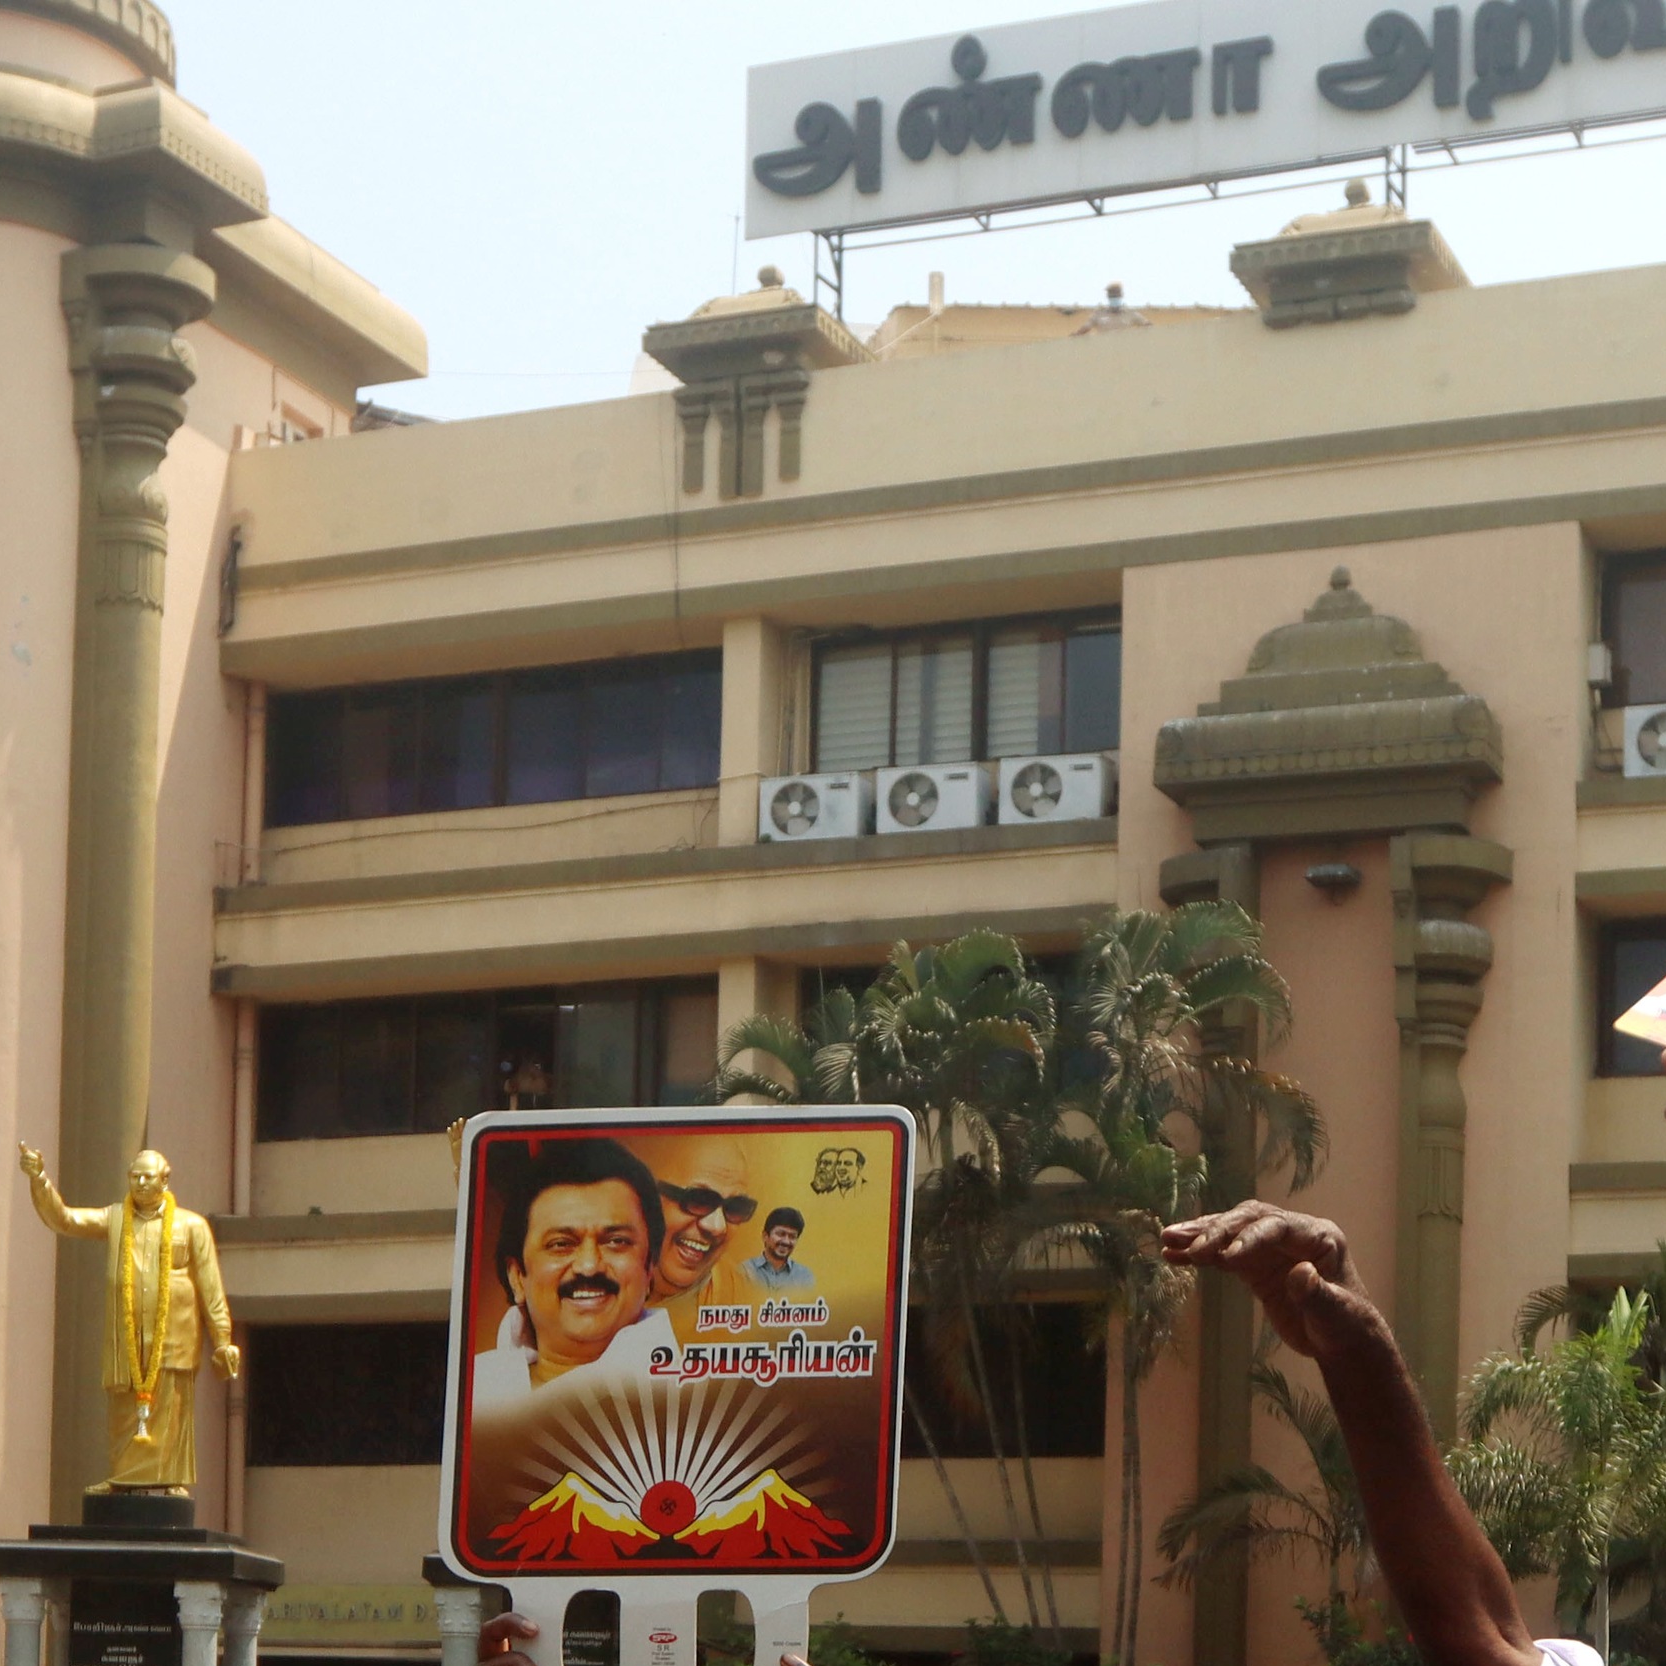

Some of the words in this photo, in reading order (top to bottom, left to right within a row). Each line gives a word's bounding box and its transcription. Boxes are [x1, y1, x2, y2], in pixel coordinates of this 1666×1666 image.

[753, 33, 1273, 196] அண்ணா
[697, 1307, 751, 1332] நமது
[758, 1299, 828, 1325] சின்னம்
[648, 1329, 875, 1385] உதயசூரியன்
